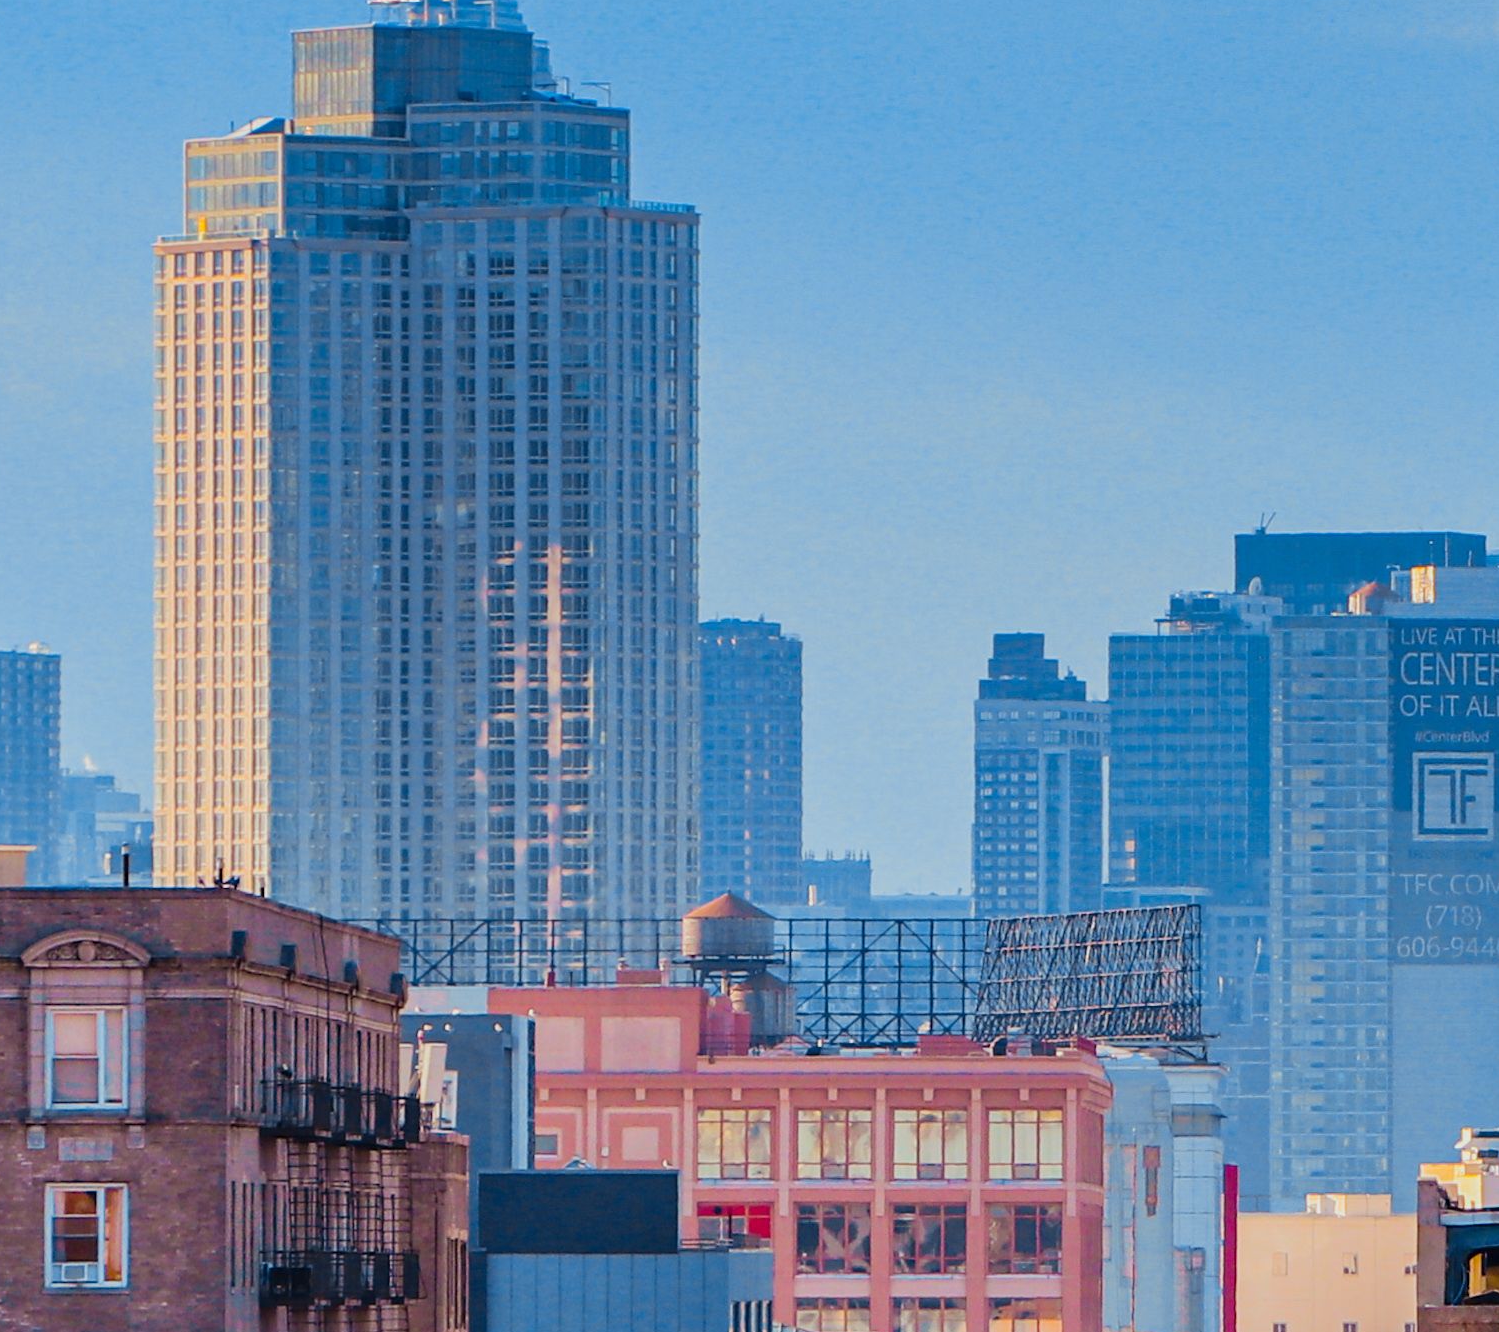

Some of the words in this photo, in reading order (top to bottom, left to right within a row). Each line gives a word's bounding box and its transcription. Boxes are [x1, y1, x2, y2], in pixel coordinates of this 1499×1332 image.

[1401, 627, 1438, 646] LIVE
[1443, 627, 1466, 646] AT
[1399, 694, 1432, 717] OF
[1440, 694, 1460, 717] IT
[1425, 904, 1483, 930] (718)
